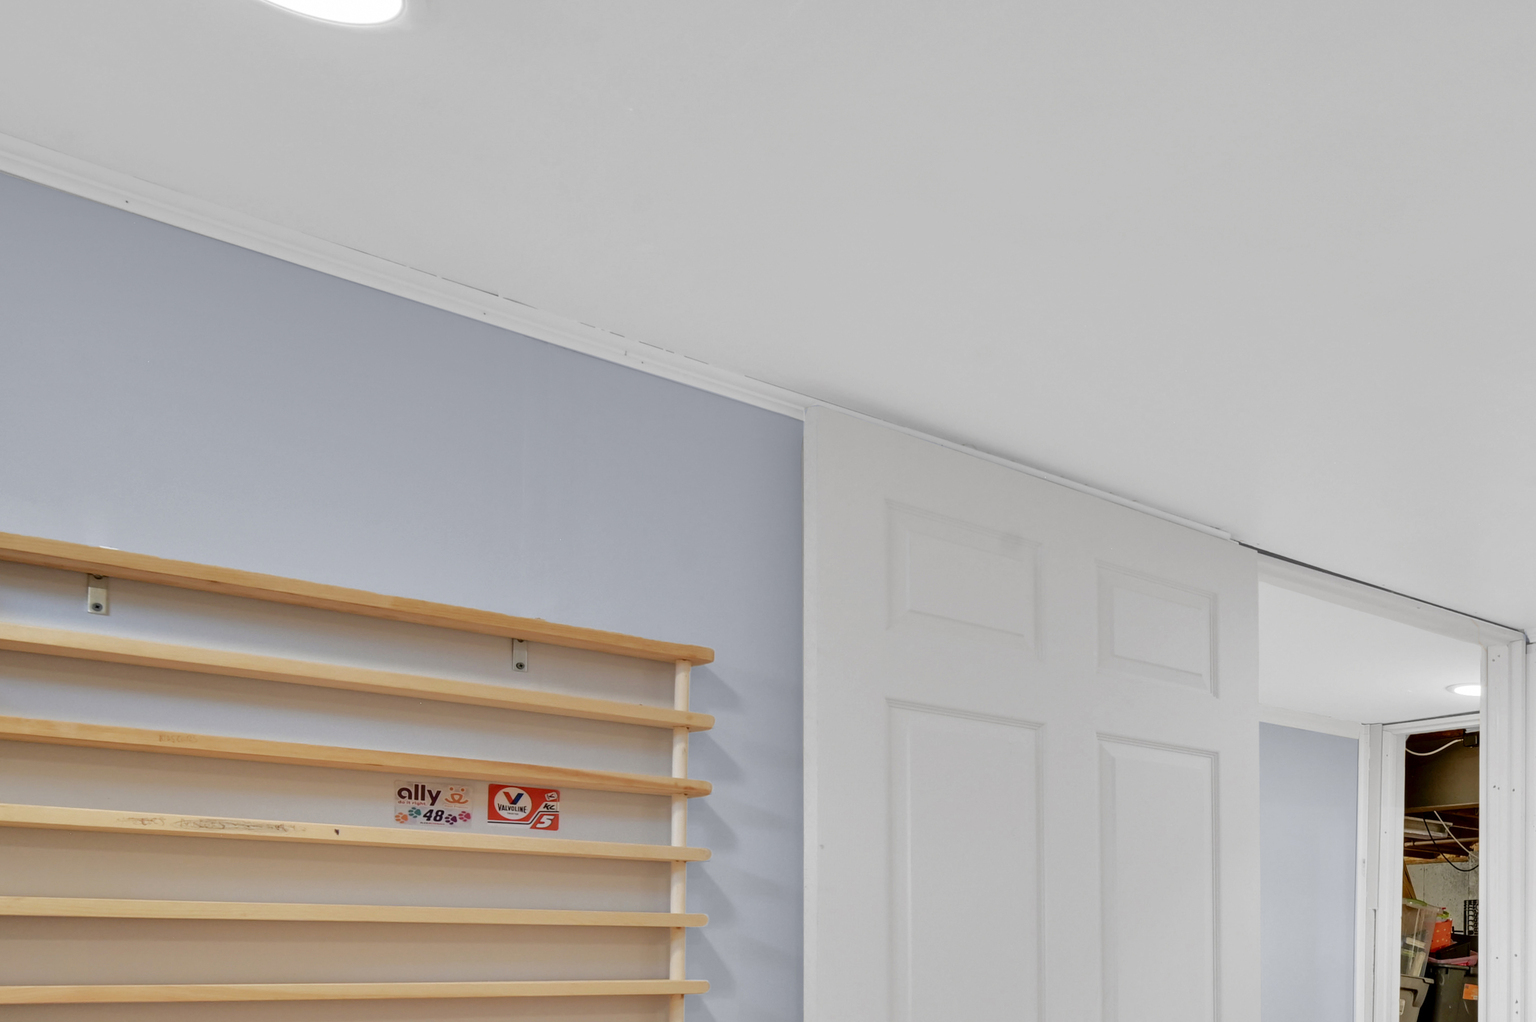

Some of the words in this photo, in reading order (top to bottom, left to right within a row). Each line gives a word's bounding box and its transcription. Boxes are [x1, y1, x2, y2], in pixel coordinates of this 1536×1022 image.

[397, 784, 441, 806] ally
[497, 803, 527, 814] VALVOLINE
[423, 809, 444, 822] 48
[535, 815, 555, 828] 5
